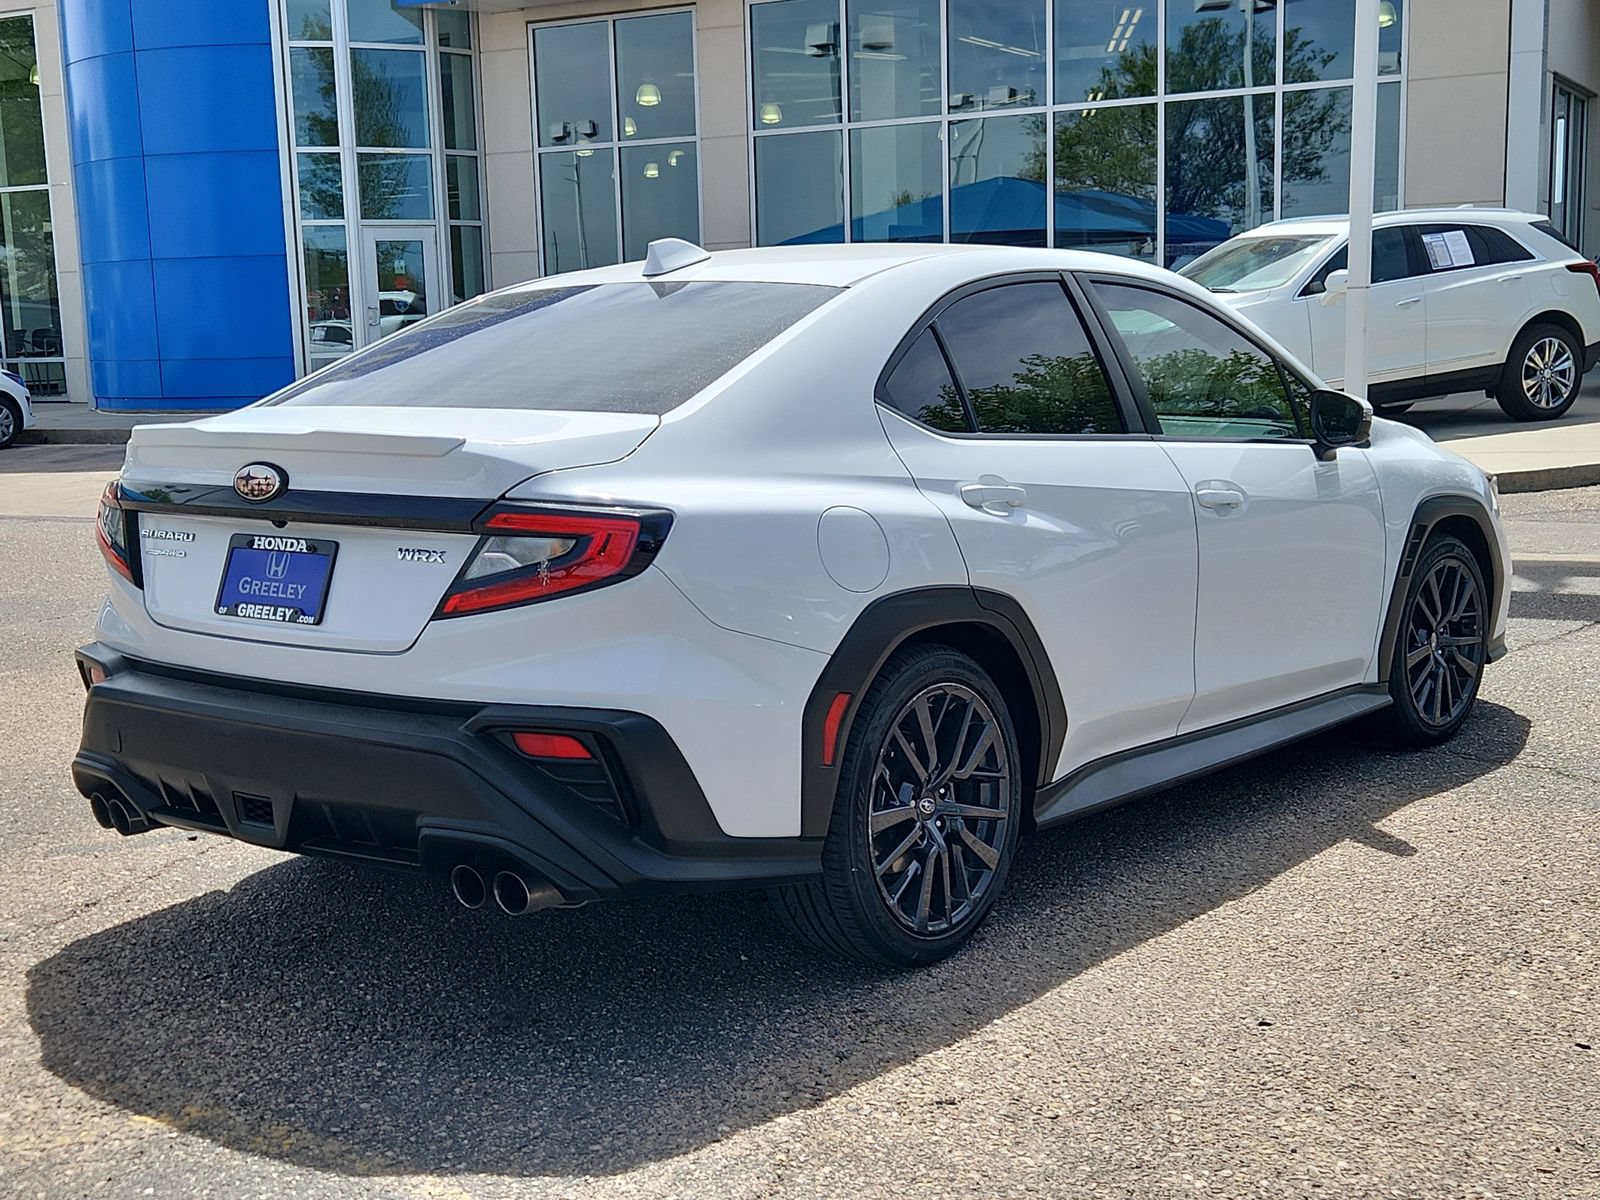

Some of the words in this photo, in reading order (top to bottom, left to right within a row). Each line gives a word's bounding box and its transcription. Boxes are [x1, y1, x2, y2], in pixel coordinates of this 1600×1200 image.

[141, 529, 196, 543] SUBARU
[252, 536, 308, 553] HONDA
[397, 547, 447, 564] WRX
[238, 576, 307, 600] GREELEY
[218, 606, 228, 614] OF
[237, 603, 294, 622] GREELEY
